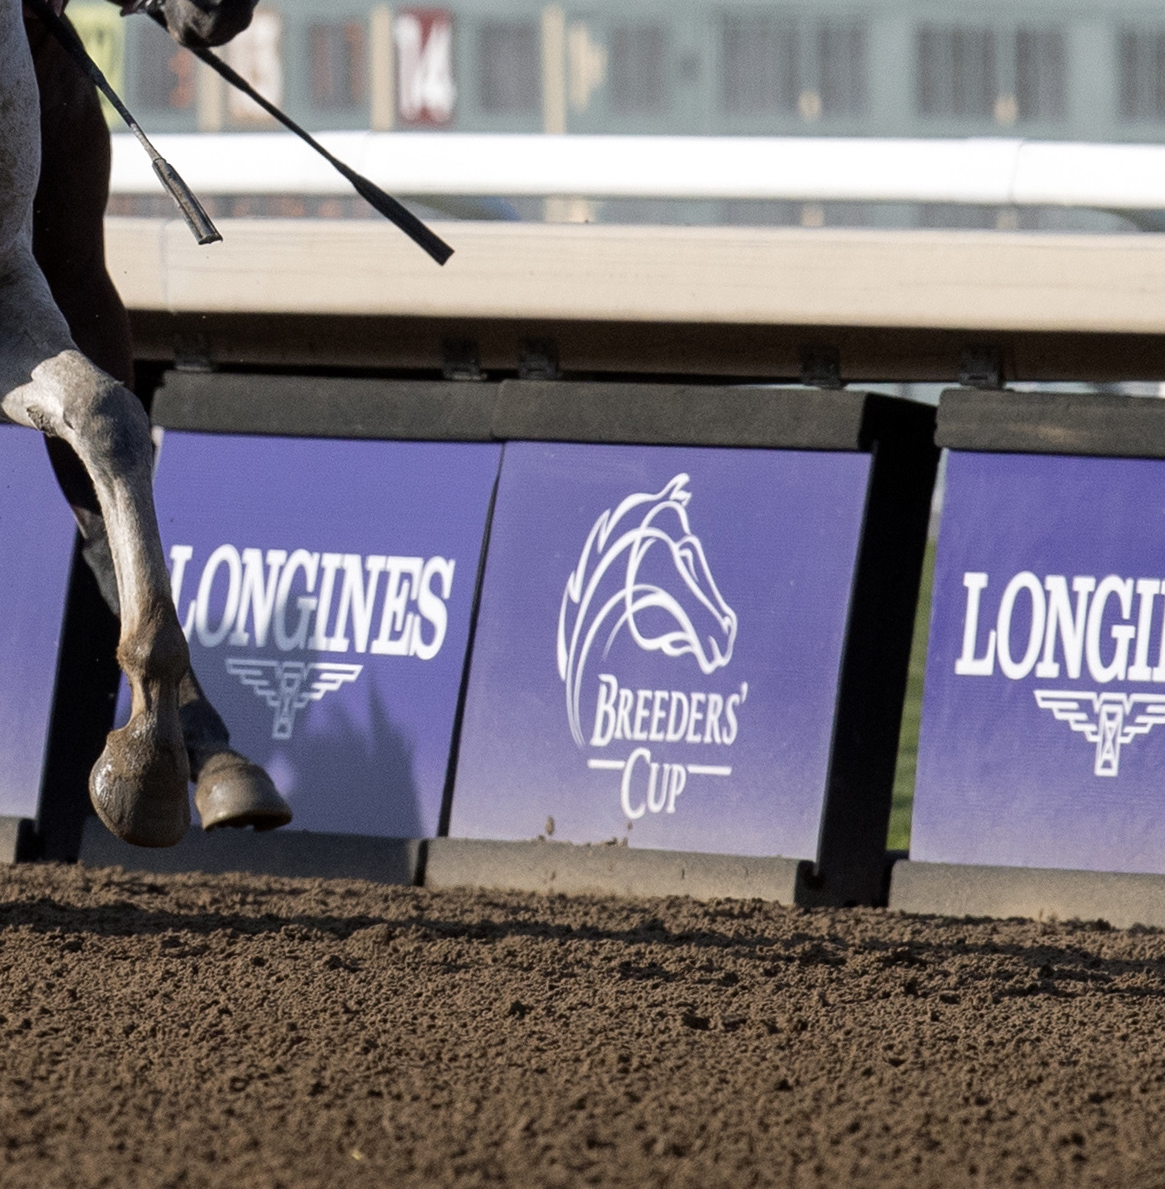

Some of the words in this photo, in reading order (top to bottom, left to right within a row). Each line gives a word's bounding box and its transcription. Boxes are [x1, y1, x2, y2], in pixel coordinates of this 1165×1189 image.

[169, 543, 455, 660] LONGINES
[589, 673, 748, 747] BREEDERS'
[620, 747, 687, 820] CUP
